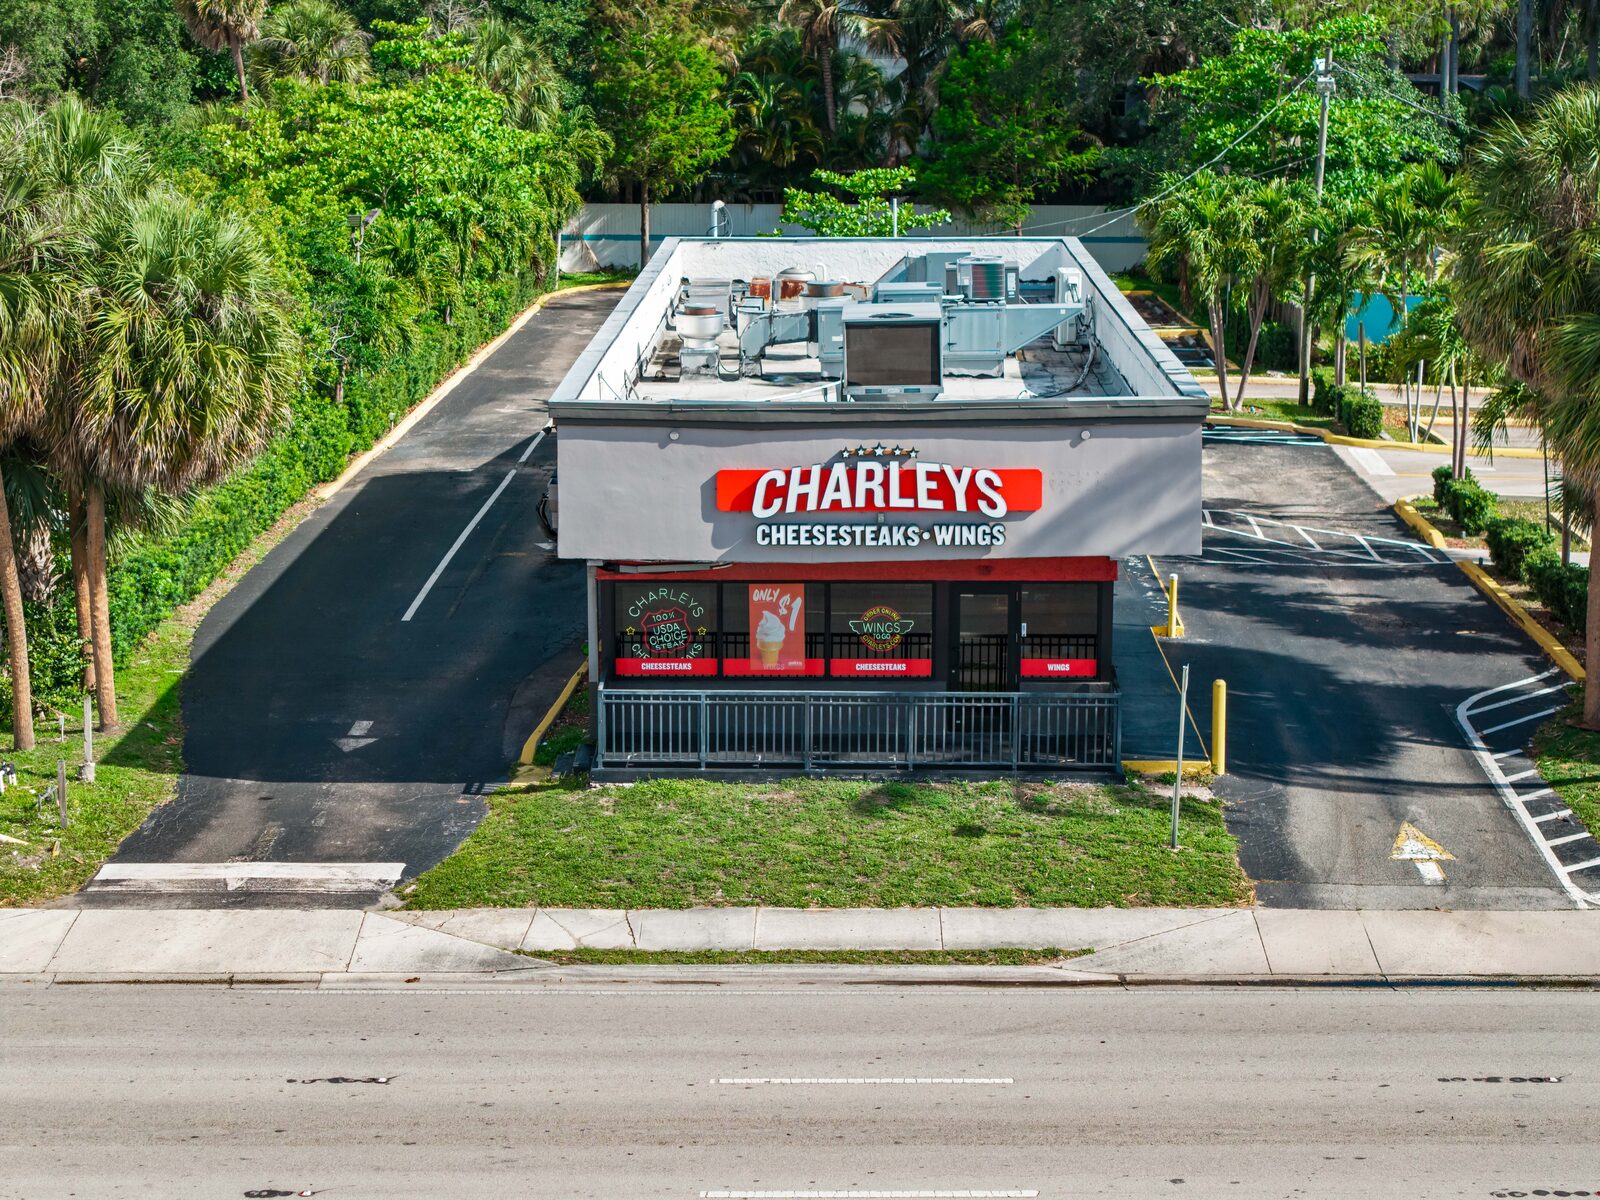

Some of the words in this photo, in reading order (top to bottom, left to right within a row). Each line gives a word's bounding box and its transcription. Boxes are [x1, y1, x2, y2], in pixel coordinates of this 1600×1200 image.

[751, 460, 1008, 519] CHARLEYS
[756, 523, 920, 547] CHEESESTEAKS
[933, 523, 1006, 547] WINGS
[752, 588, 780, 603] ONLY
[628, 588, 704, 618] CHARLEYS
[652, 611, 675, 622] 100%
[778, 593, 803, 632] $1
[653, 622, 681, 635] USDA
[862, 622, 901, 633] WINGS
[649, 629, 688, 646] CHOICE
[655, 639, 685, 651] STEAK
[641, 662, 692, 671] CHEESESTEAKS
[855, 663, 906, 671] CHEESESTEAKS
[1047, 663, 1070, 671] WINGS
